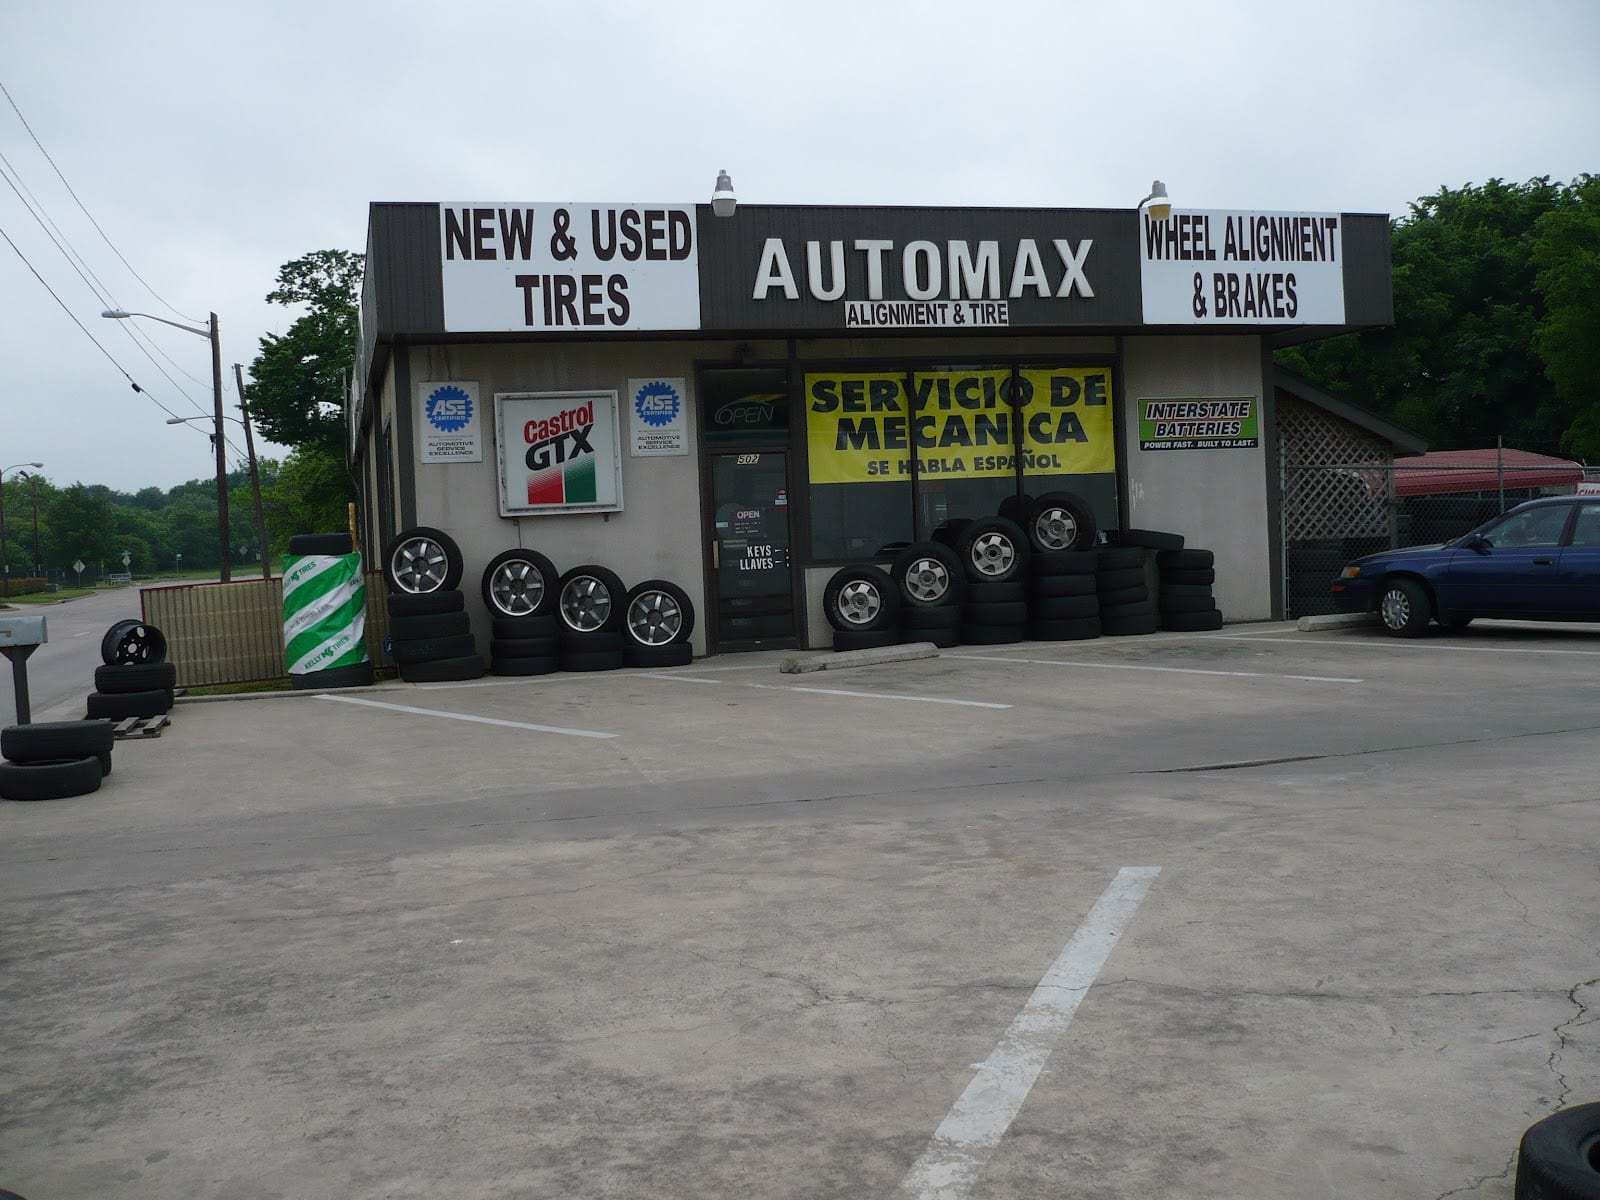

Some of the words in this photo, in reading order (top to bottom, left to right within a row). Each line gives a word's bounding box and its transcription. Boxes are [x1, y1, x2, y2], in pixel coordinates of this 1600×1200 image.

[445, 208, 534, 261] NEW
[550, 208, 578, 262] &
[591, 209, 692, 261] USED
[1144, 214, 1216, 261] WHEEL
[1224, 215, 1337, 262] ALIGNMENT
[752, 238, 1095, 301] AUTOMAX
[515, 274, 630, 326] TIRES
[1192, 272, 1208, 318] &
[1213, 272, 1298, 318] BRAKES
[847, 302, 948, 326] ALIGNMENT
[953, 302, 965, 325] &
[968, 302, 1008, 325] TIRE
[641, 395, 672, 410] ASE
[811, 376, 1034, 413] SERVICIO
[1050, 374, 1107, 407] DE
[432, 400, 466, 415] ASE
[718, 405, 775, 425] OPEN
[1146, 401, 1251, 420] INTERSTATE
[524, 400, 595, 444] Castrol
[1155, 421, 1241, 438] BATTERIES
[525, 424, 595, 471] GTX
[1144, 441, 1172, 449] POWER
[1198, 440, 1219, 448] BUILT
[1232, 439, 1254, 447] LAST.
[738, 454, 759, 464] 502
[867, 460, 890, 475] SE
[898, 456, 966, 475] HABLA
[736, 510, 760, 519] OPEN
[747, 545, 772, 557] KEYS
[299, 561, 317, 576] TIRES
[740, 558, 774, 571] LLAVES
[304, 655, 322, 670] KELLY
